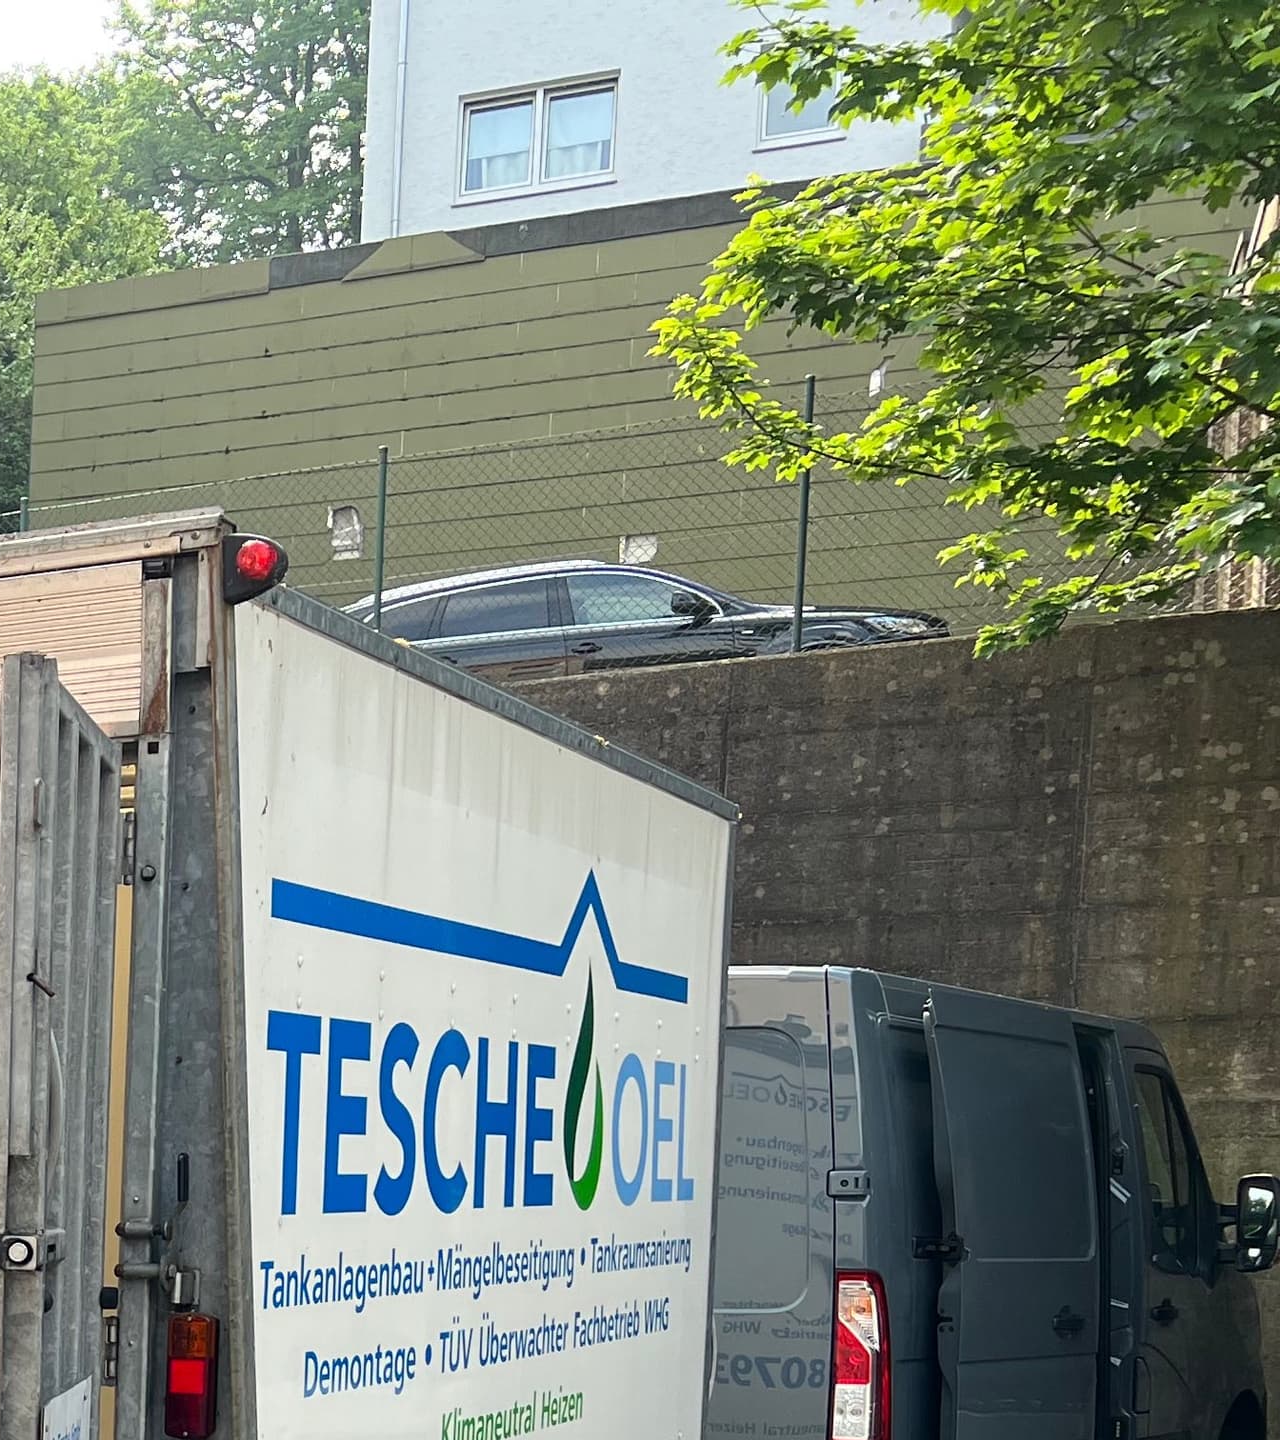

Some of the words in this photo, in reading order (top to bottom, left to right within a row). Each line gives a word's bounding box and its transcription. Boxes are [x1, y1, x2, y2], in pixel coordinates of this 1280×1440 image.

[267, 1010, 556, 1216] TESCHE
[611, 1053, 694, 1206] OEL
[590, 1231, 691, 1273] Tankraumsanierung
[304, 1345, 416, 1398] Demontage
[440, 1316, 473, 1373] TÜV
[479, 1312, 569, 1367] Überwachter
[573, 1301, 639, 1349] Fachbetrieb
[644, 1297, 670, 1332] WHG
[540, 1386, 583, 1429] Heizen
